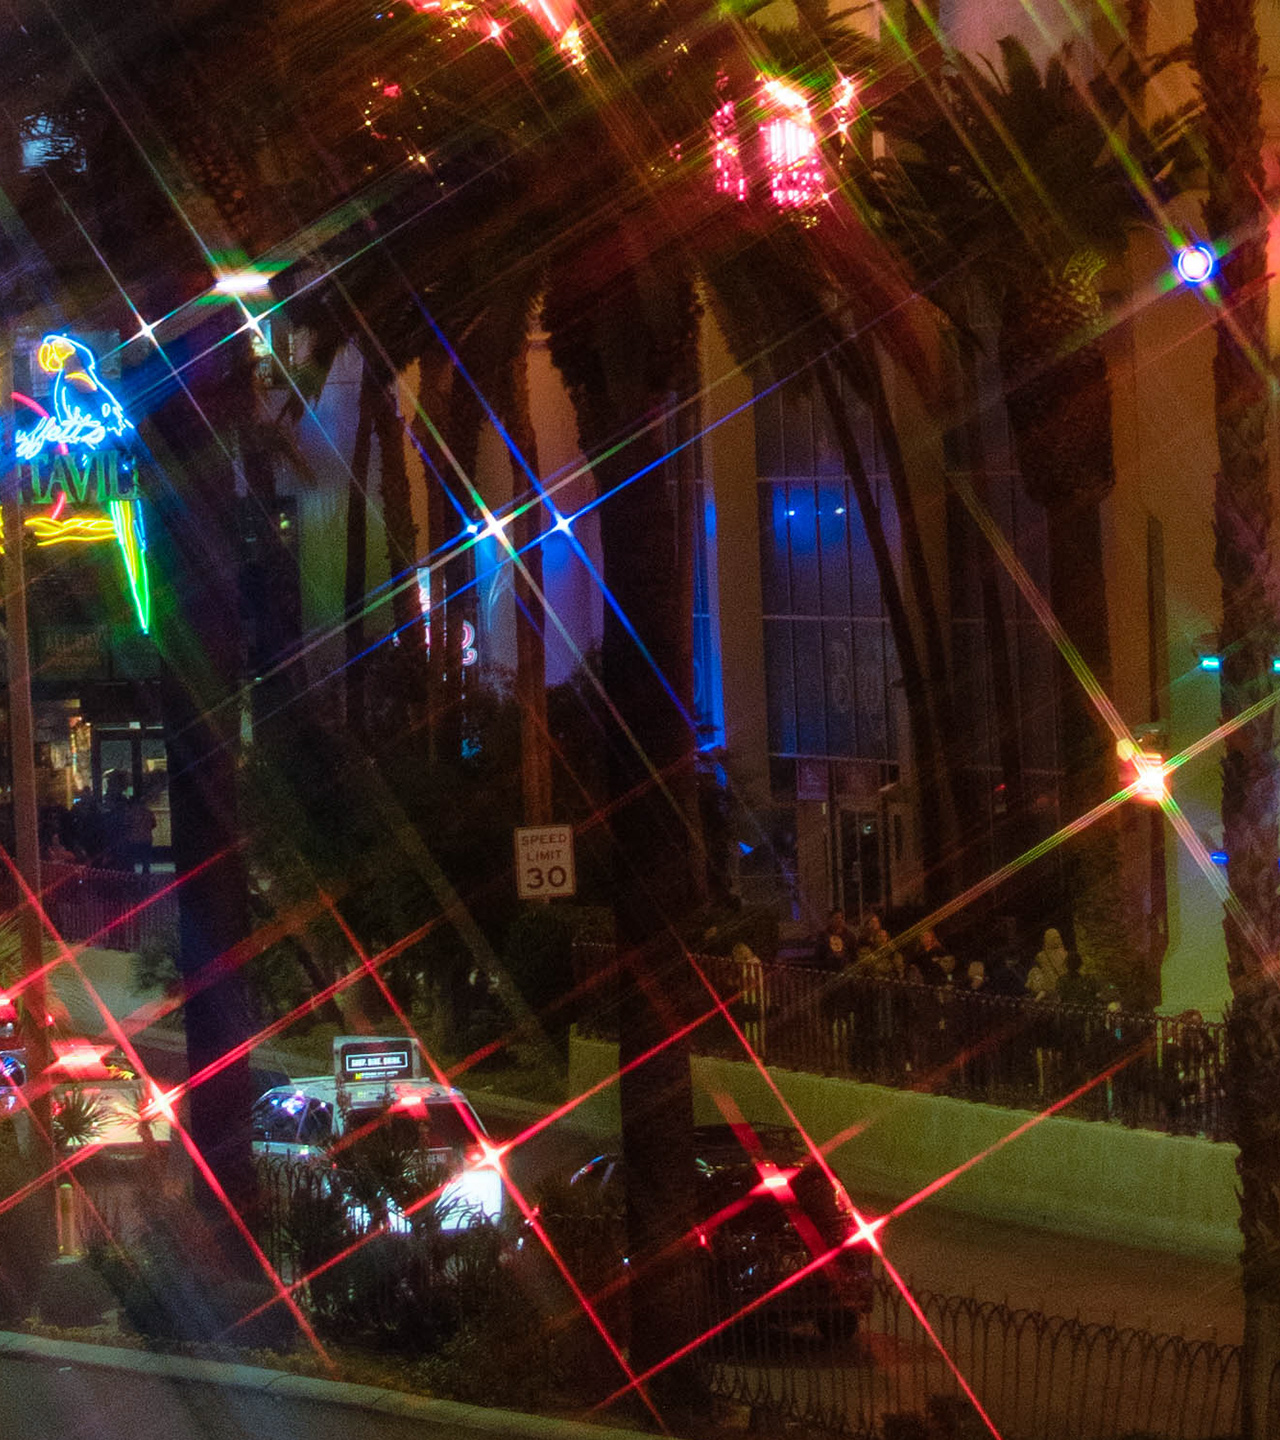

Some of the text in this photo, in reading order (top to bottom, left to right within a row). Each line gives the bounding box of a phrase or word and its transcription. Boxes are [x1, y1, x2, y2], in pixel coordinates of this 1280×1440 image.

[521, 833, 568, 846] SPEED
[526, 849, 563, 862] LIMIT
[526, 865, 568, 889] 30
